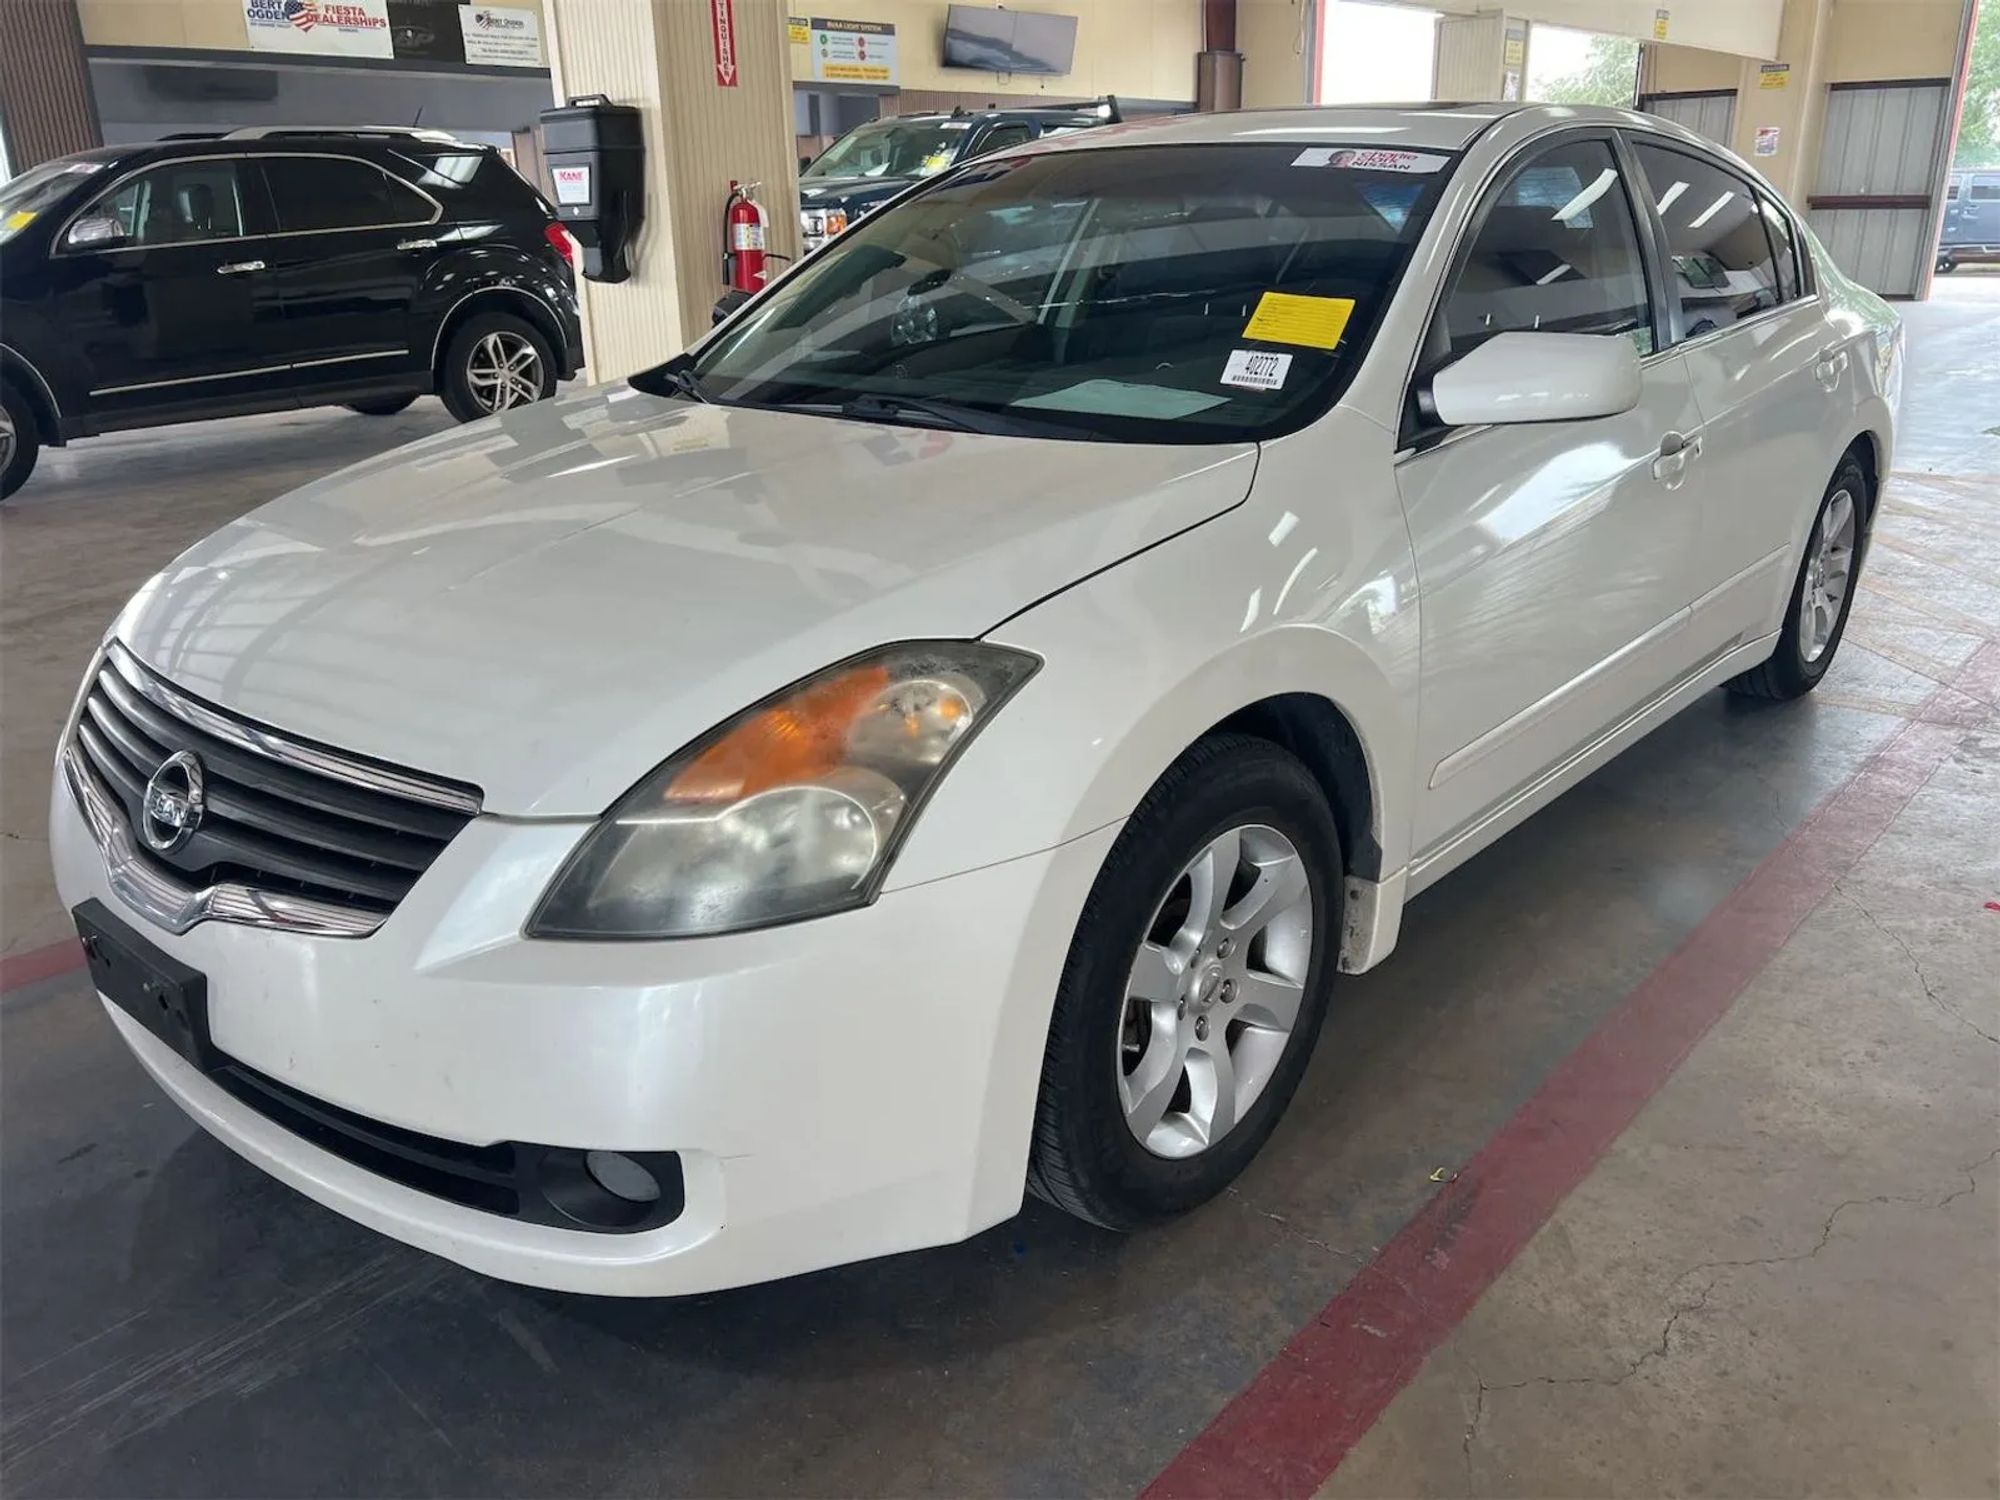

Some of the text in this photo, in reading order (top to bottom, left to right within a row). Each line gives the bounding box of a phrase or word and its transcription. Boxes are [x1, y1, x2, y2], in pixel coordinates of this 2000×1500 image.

[251, 0, 281, 9] BERT
[324, 4, 366, 16] FIESTA
[247, 8, 290, 20] OGDEN
[306, 12, 387, 27] DEALERSHIPS
[1351, 160, 1411, 170] NISSAN
[558, 170, 585, 182] KANE
[1244, 354, 1280, 378] 402772
